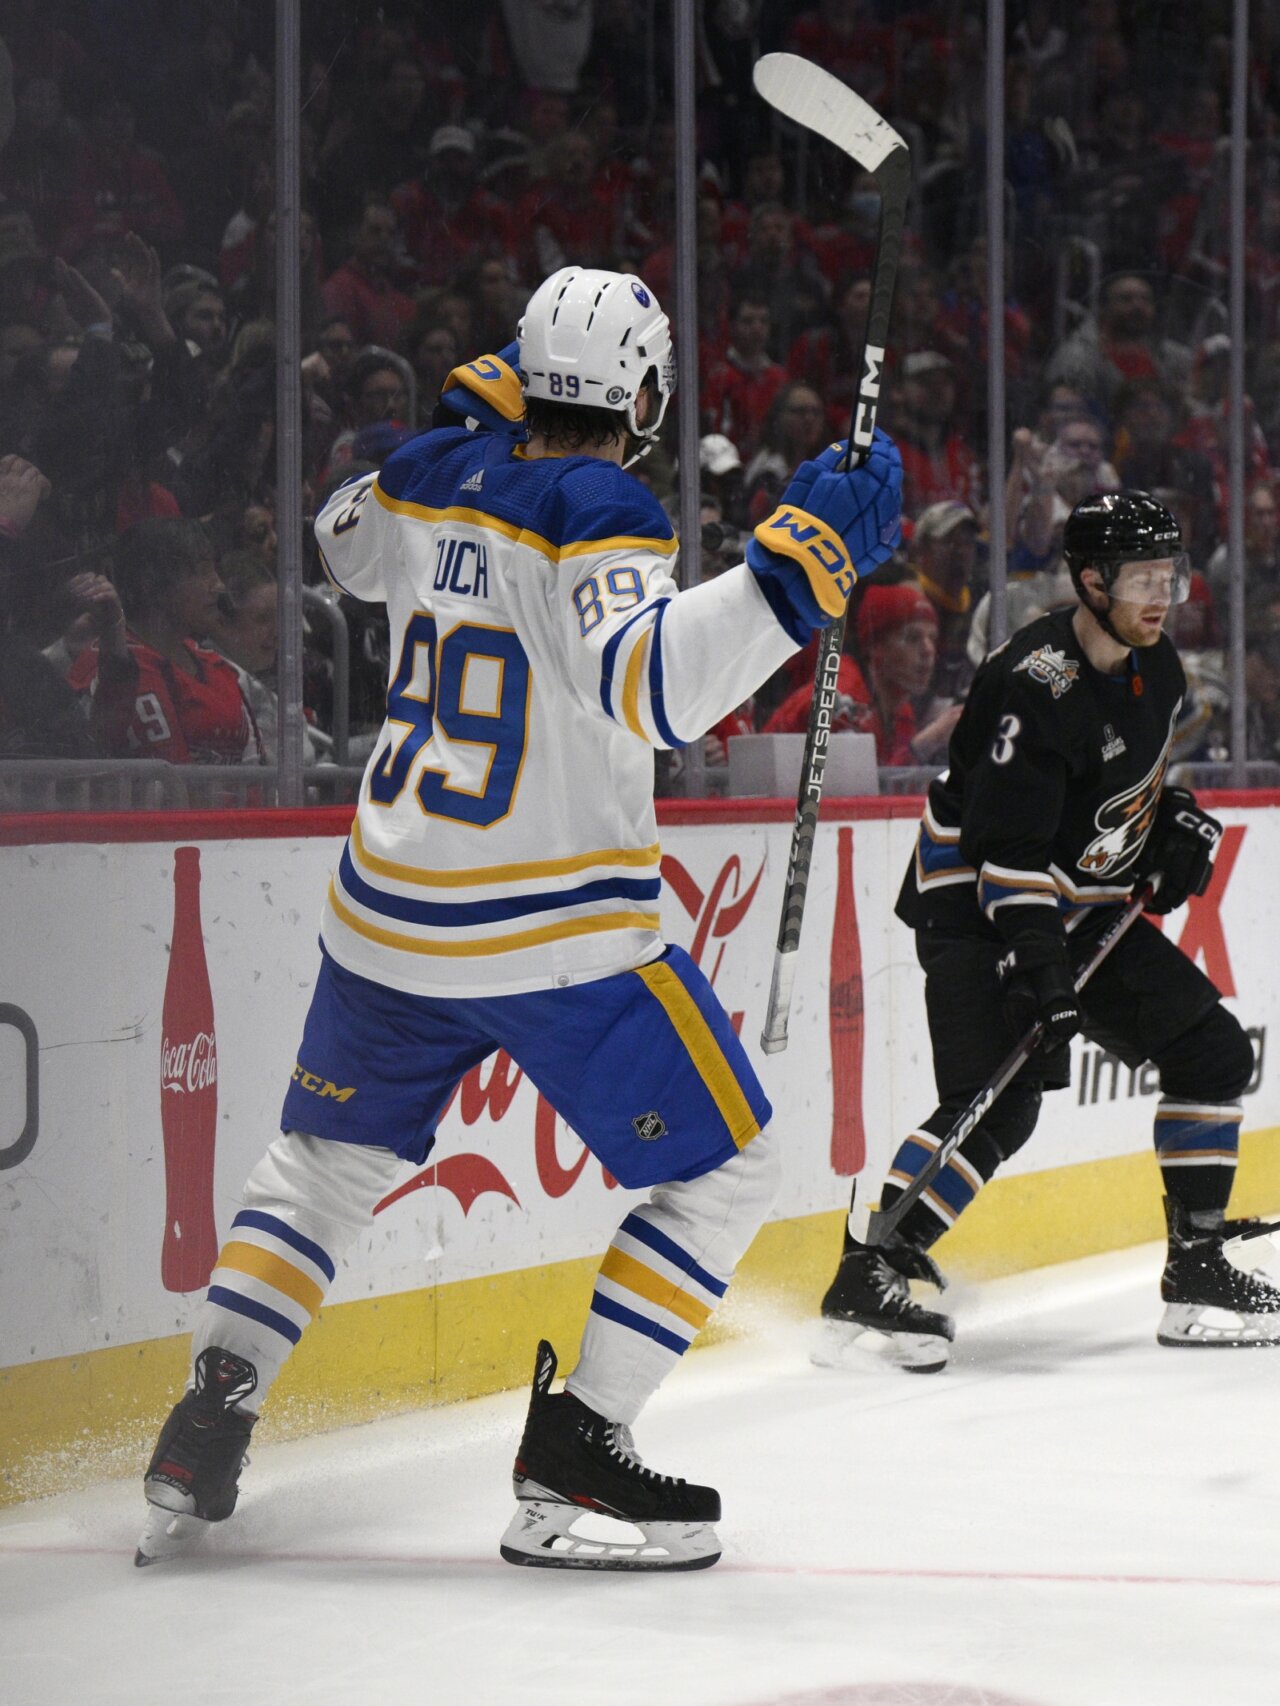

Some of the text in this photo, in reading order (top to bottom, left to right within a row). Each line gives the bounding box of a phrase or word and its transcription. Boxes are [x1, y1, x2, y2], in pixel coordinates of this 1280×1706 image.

[549, 373, 580, 398] 89
[853, 344, 885, 447] CCM
[1154, 531, 1179, 541] CCM
[433, 538, 488, 599] UCH
[573, 566, 647, 640] 89
[369, 609, 532, 831] 89
[806, 653, 841, 803] JETSPEED
[990, 713, 1021, 765] 3
[1051, 1009, 1078, 1022] CCM
[161, 1031, 216, 1094] Coca-Cola
[940, 1087, 994, 1169] CCM
